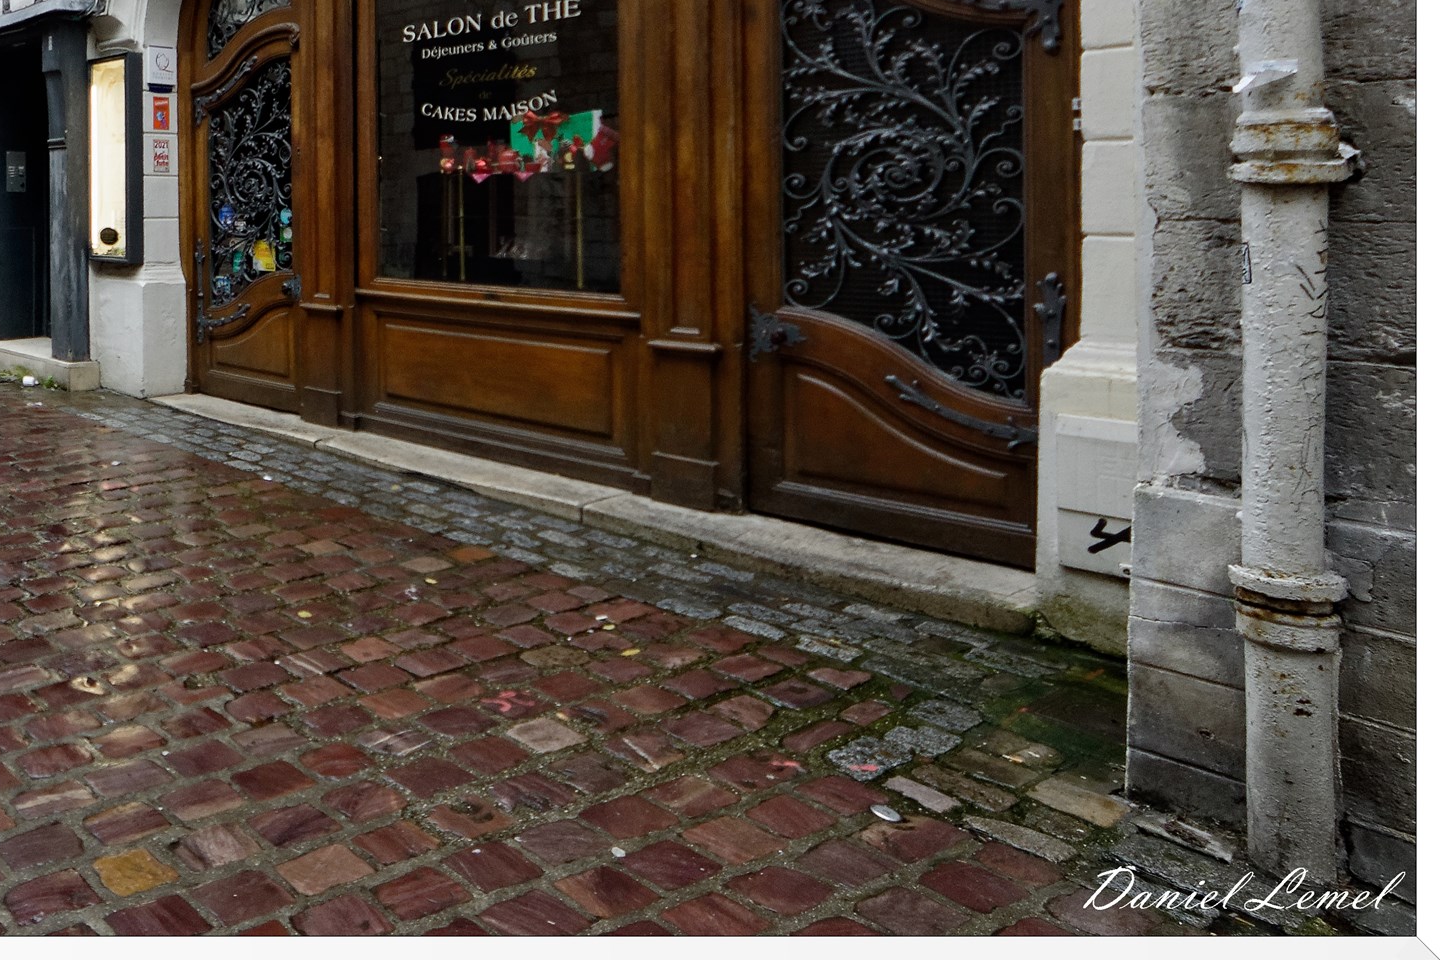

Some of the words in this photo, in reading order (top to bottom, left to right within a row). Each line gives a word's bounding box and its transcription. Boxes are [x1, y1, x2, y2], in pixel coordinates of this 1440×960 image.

[402, 13, 483, 44] SALON
[491, 9, 519, 30] de
[421, 40, 485, 60] Déjeuners
[488, 38, 498, 51] &
[502, 30, 558, 49] Goûters
[438, 63, 538, 90] Spécialités
[421, 102, 477, 122] CAKES
[482, 89, 558, 122] MAISON
